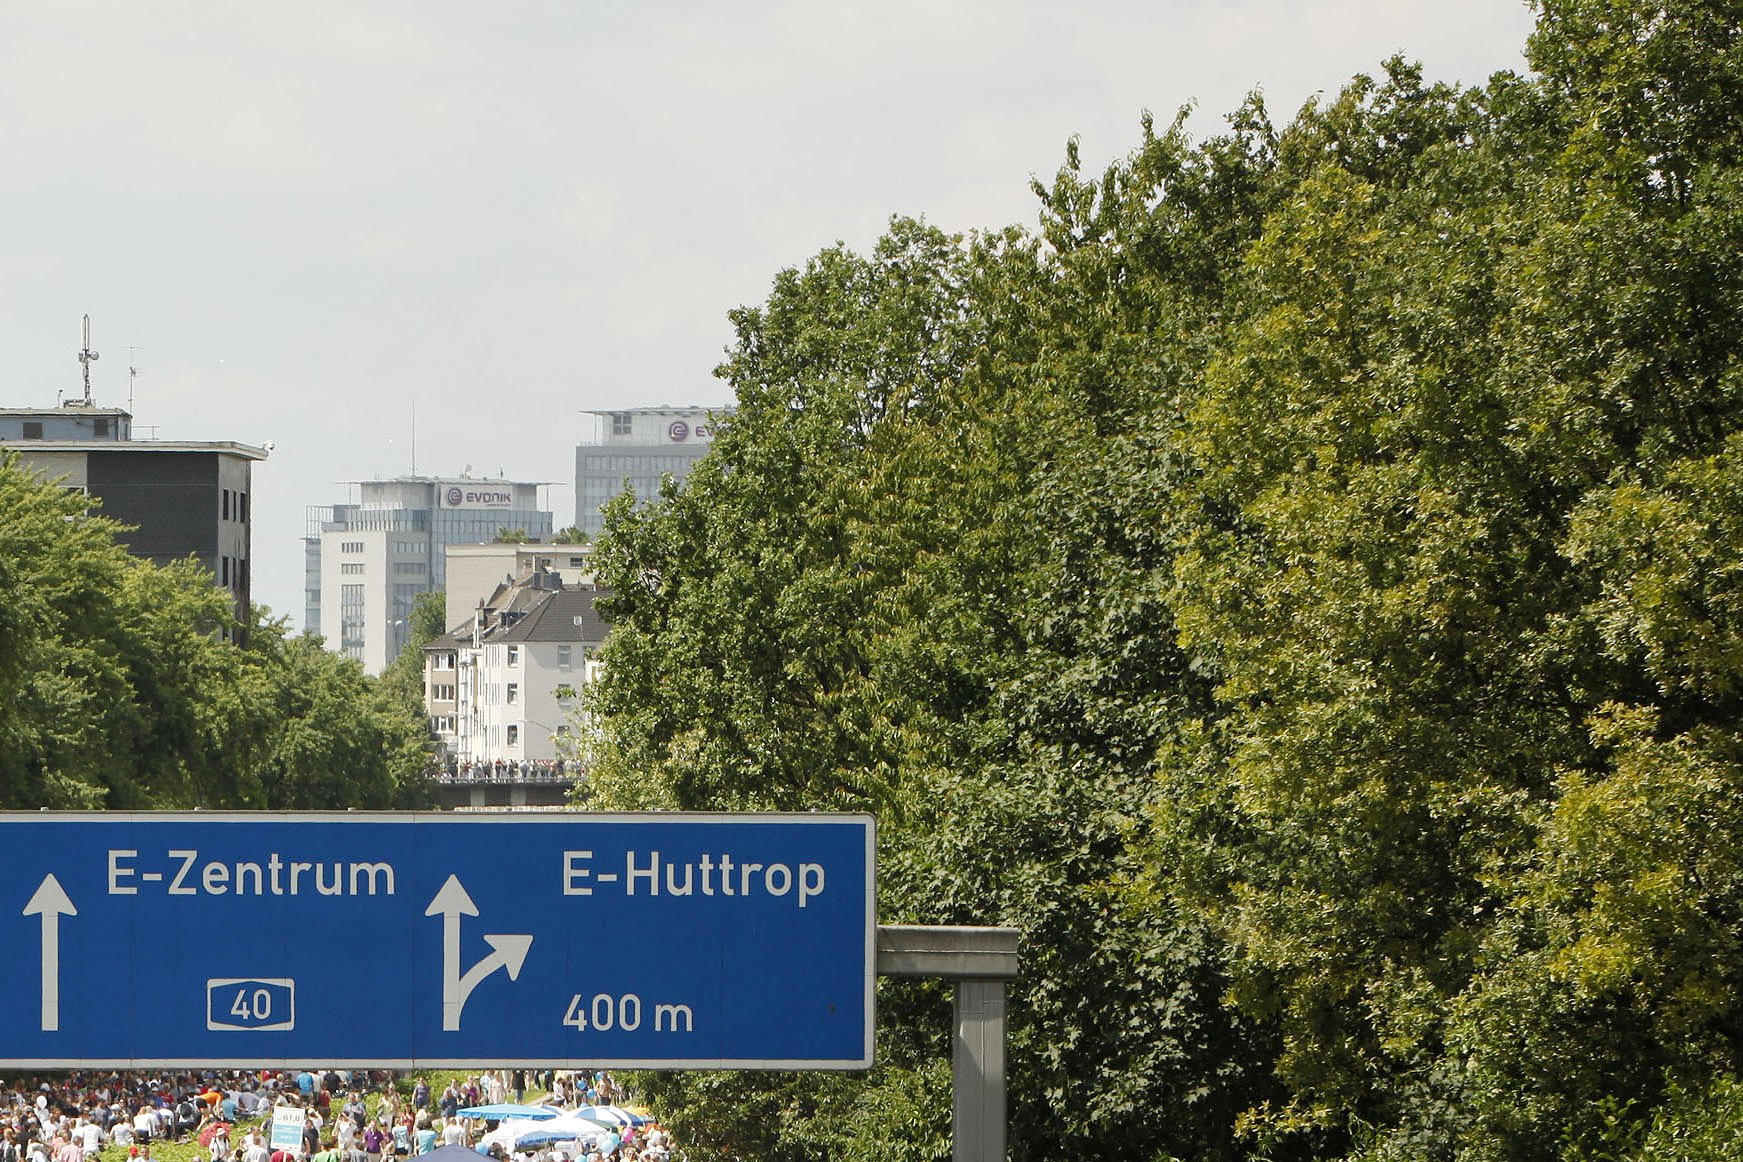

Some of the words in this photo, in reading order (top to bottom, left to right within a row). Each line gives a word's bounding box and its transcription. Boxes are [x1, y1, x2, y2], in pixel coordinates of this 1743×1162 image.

[466, 492, 512, 503] EVONIK
[108, 850, 396, 897] E-Zentrum
[563, 850, 827, 909] E-Huttrop
[230, 989, 273, 1021] 40
[562, 993, 643, 1034] 400
[655, 1004, 695, 1034] m
